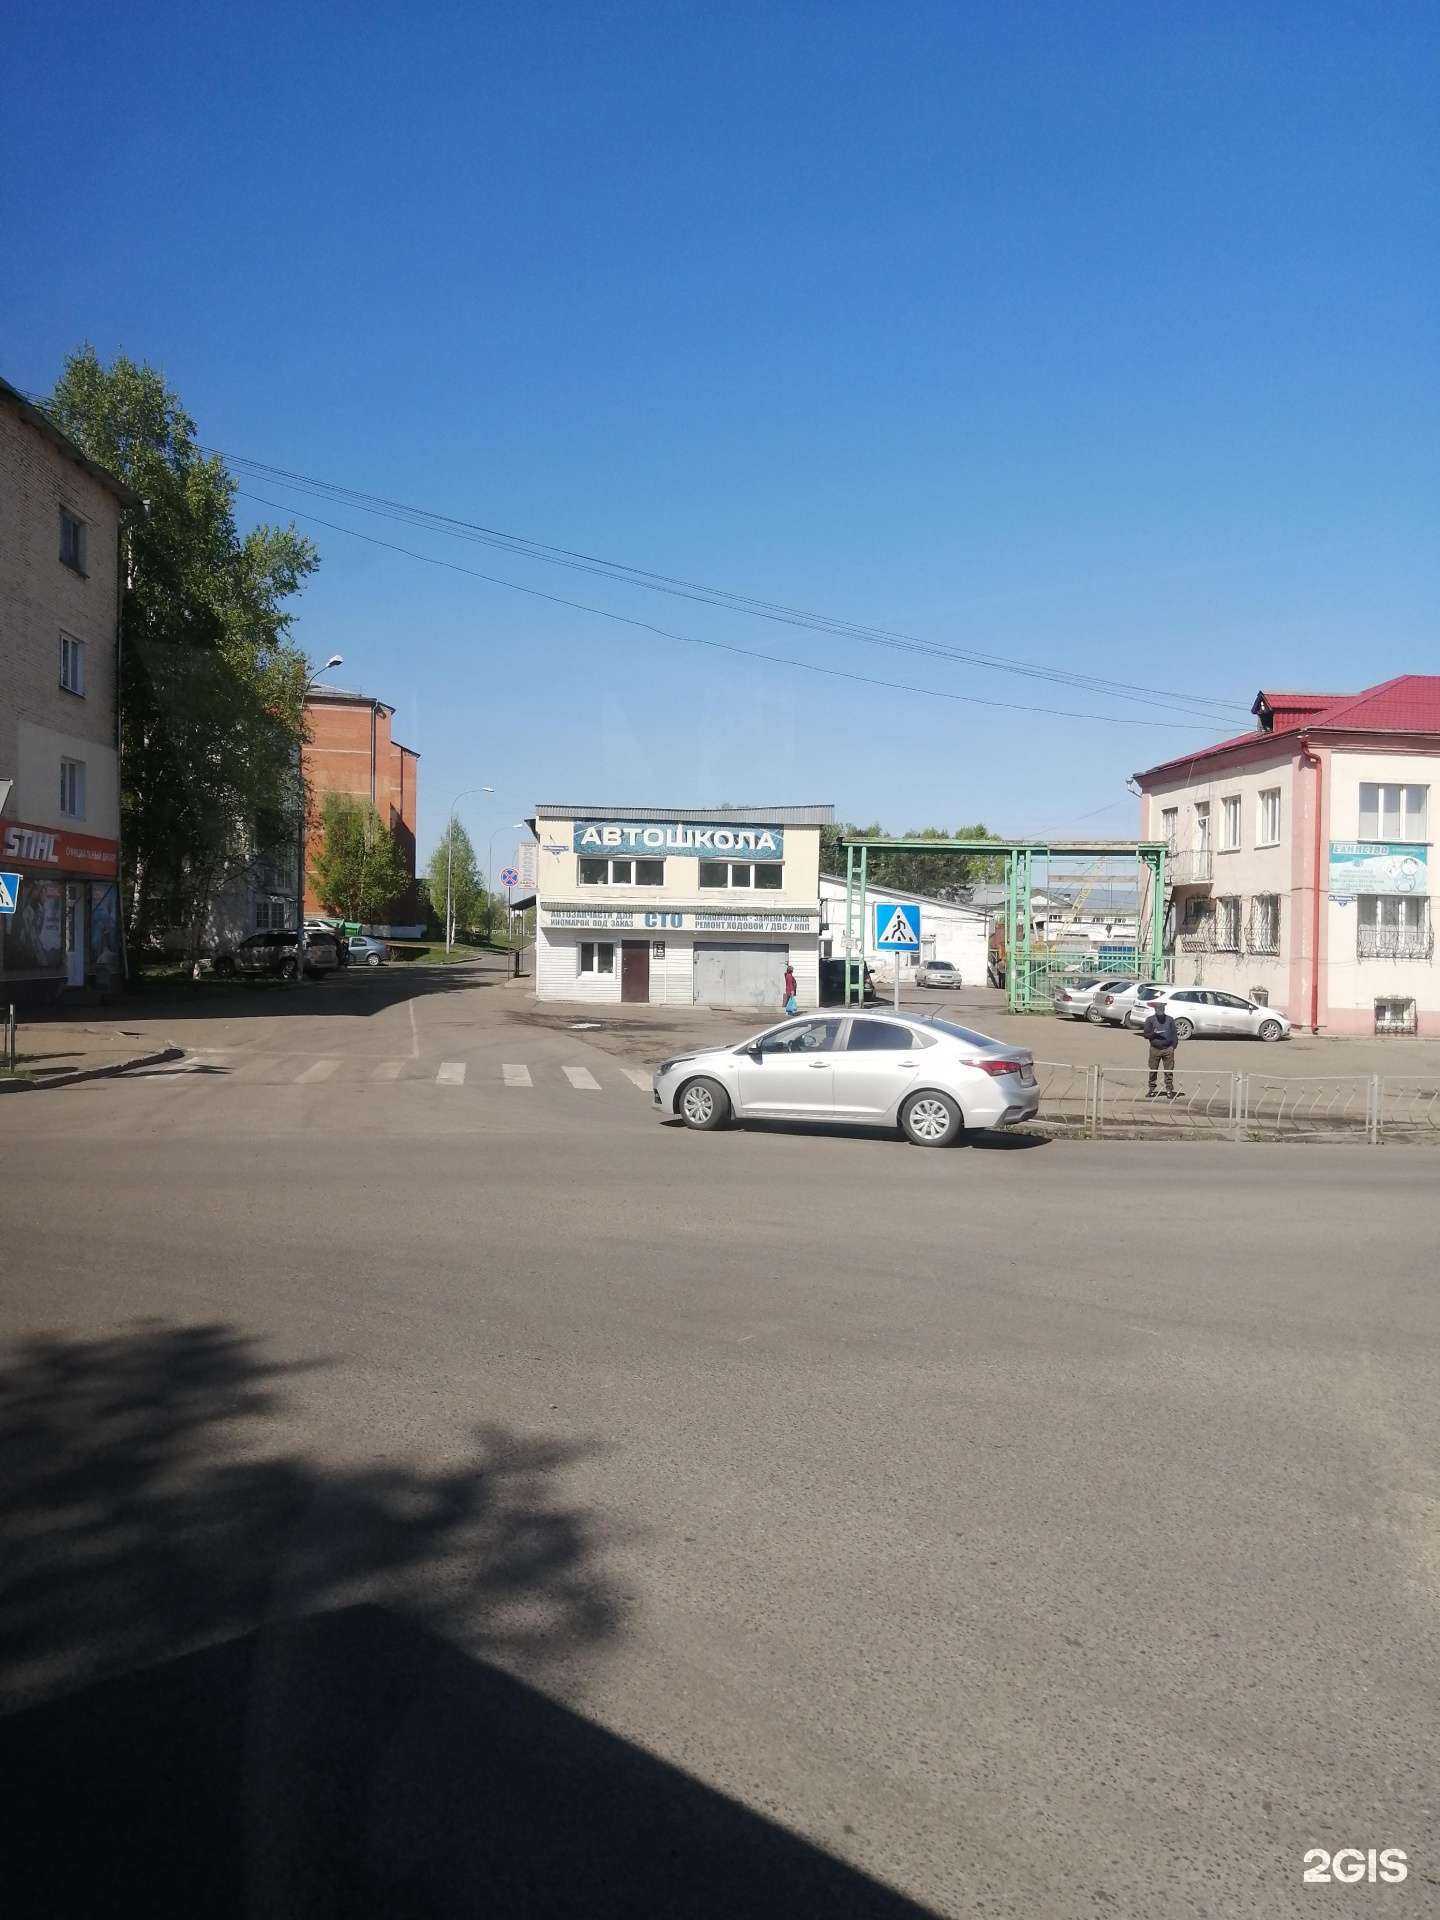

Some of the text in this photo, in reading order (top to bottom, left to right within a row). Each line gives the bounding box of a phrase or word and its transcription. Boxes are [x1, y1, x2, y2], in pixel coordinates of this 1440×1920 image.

[6, 827, 59, 863] STIHL
[580, 824, 776, 850] АВТОШКОЛА
[611, 920, 634, 928] ЗАКАЗ
[644, 912, 683, 928] СТО
[695, 921, 725, 929] РЕМОНТ
[726, 921, 763, 930] ХОДОВОЙ
